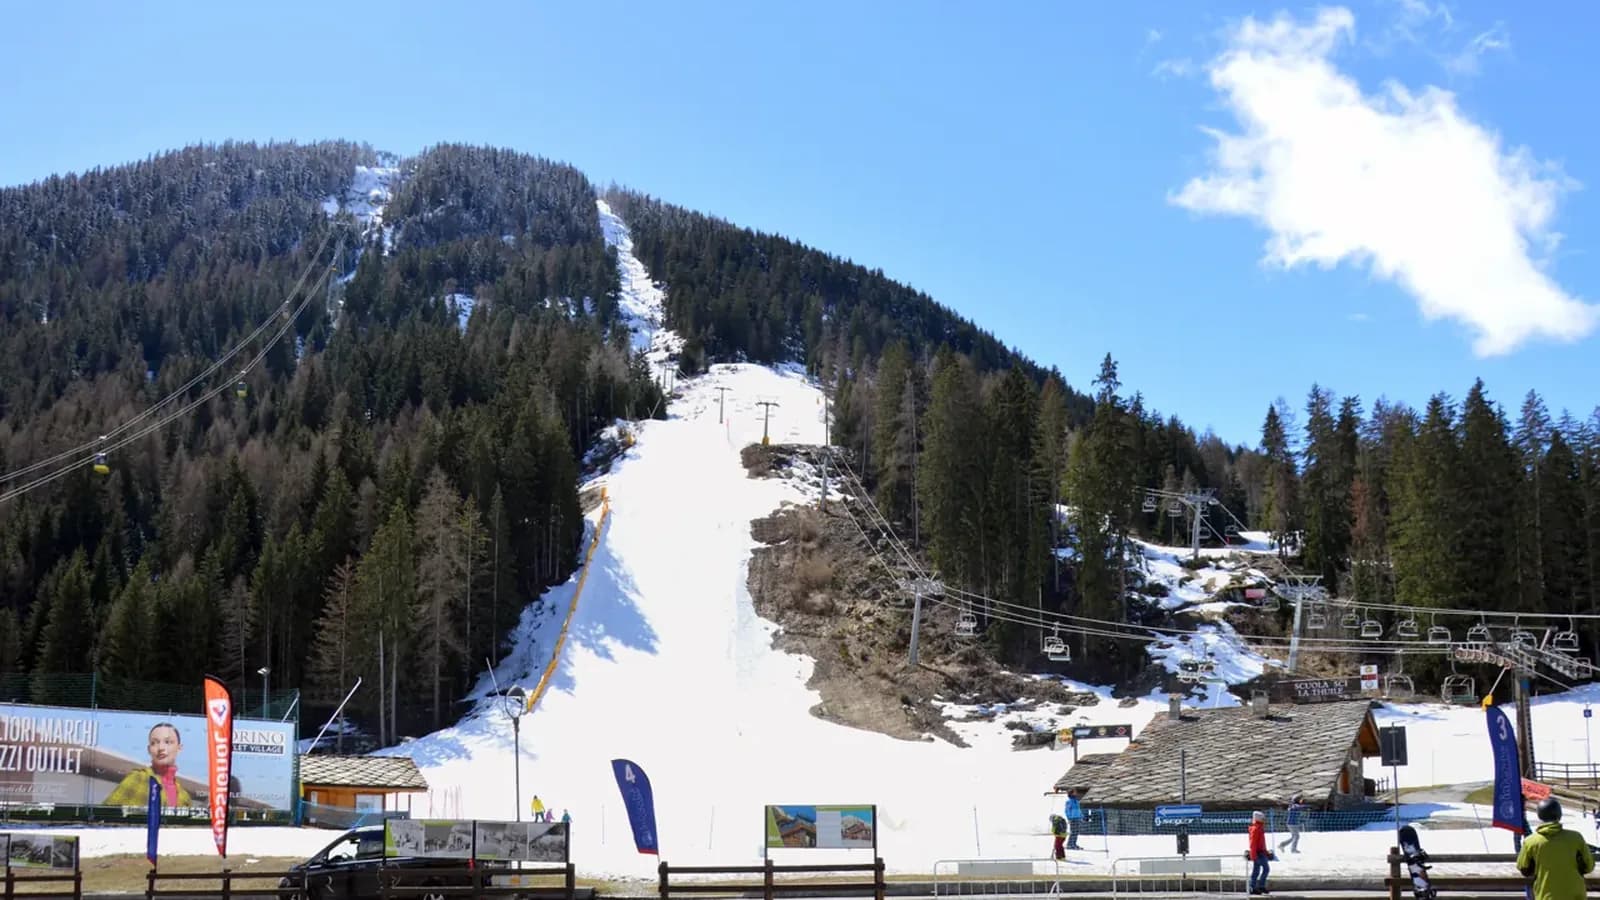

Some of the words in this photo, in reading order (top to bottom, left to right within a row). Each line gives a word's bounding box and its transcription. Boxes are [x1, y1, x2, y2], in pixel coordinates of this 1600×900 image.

[1294, 681, 1329, 690] SCUOLA
[1333, 679, 1348, 687] SCI
[1297, 689, 1310, 697] LA
[1311, 687, 1344, 696] THUILE
[0, 714, 37, 743] IORI
[40, 717, 98, 746] MARCHI
[1496, 714, 1507, 740] 3
[250, 745, 282, 753] VILLAGE
[26, 745, 83, 774] OUTLET
[625, 763, 635, 783] 4
